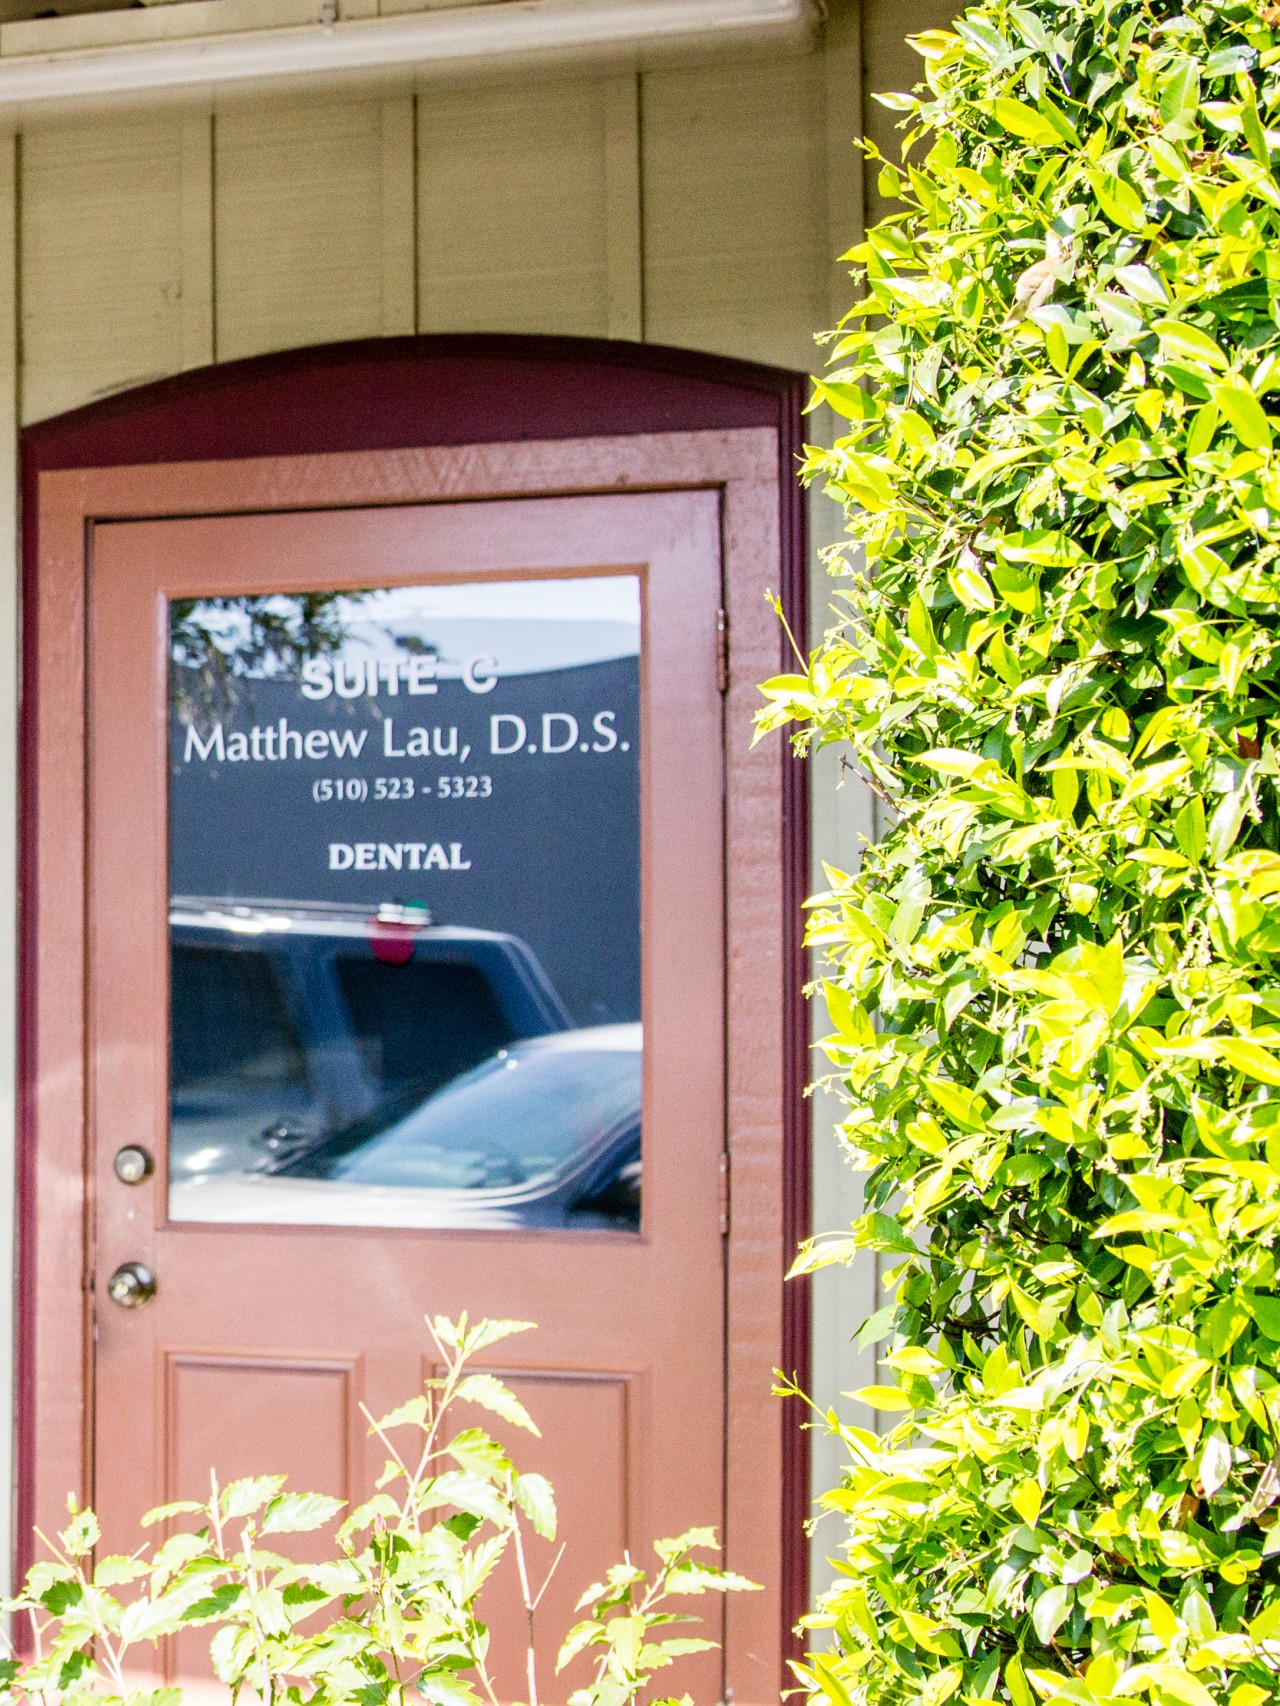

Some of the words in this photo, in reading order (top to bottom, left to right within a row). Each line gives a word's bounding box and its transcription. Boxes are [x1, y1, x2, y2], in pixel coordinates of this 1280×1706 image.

[301, 654, 438, 700] SUITE
[462, 652, 499, 695] C
[184, 717, 368, 763] Matthew
[383, 717, 472, 763] Lau,
[489, 711, 631, 755] D.D.S.
[312, 778, 369, 803] (510)
[374, 777, 415, 800] 523
[437, 775, 493, 799] 5323
[329, 842, 472, 871] DENTAL
